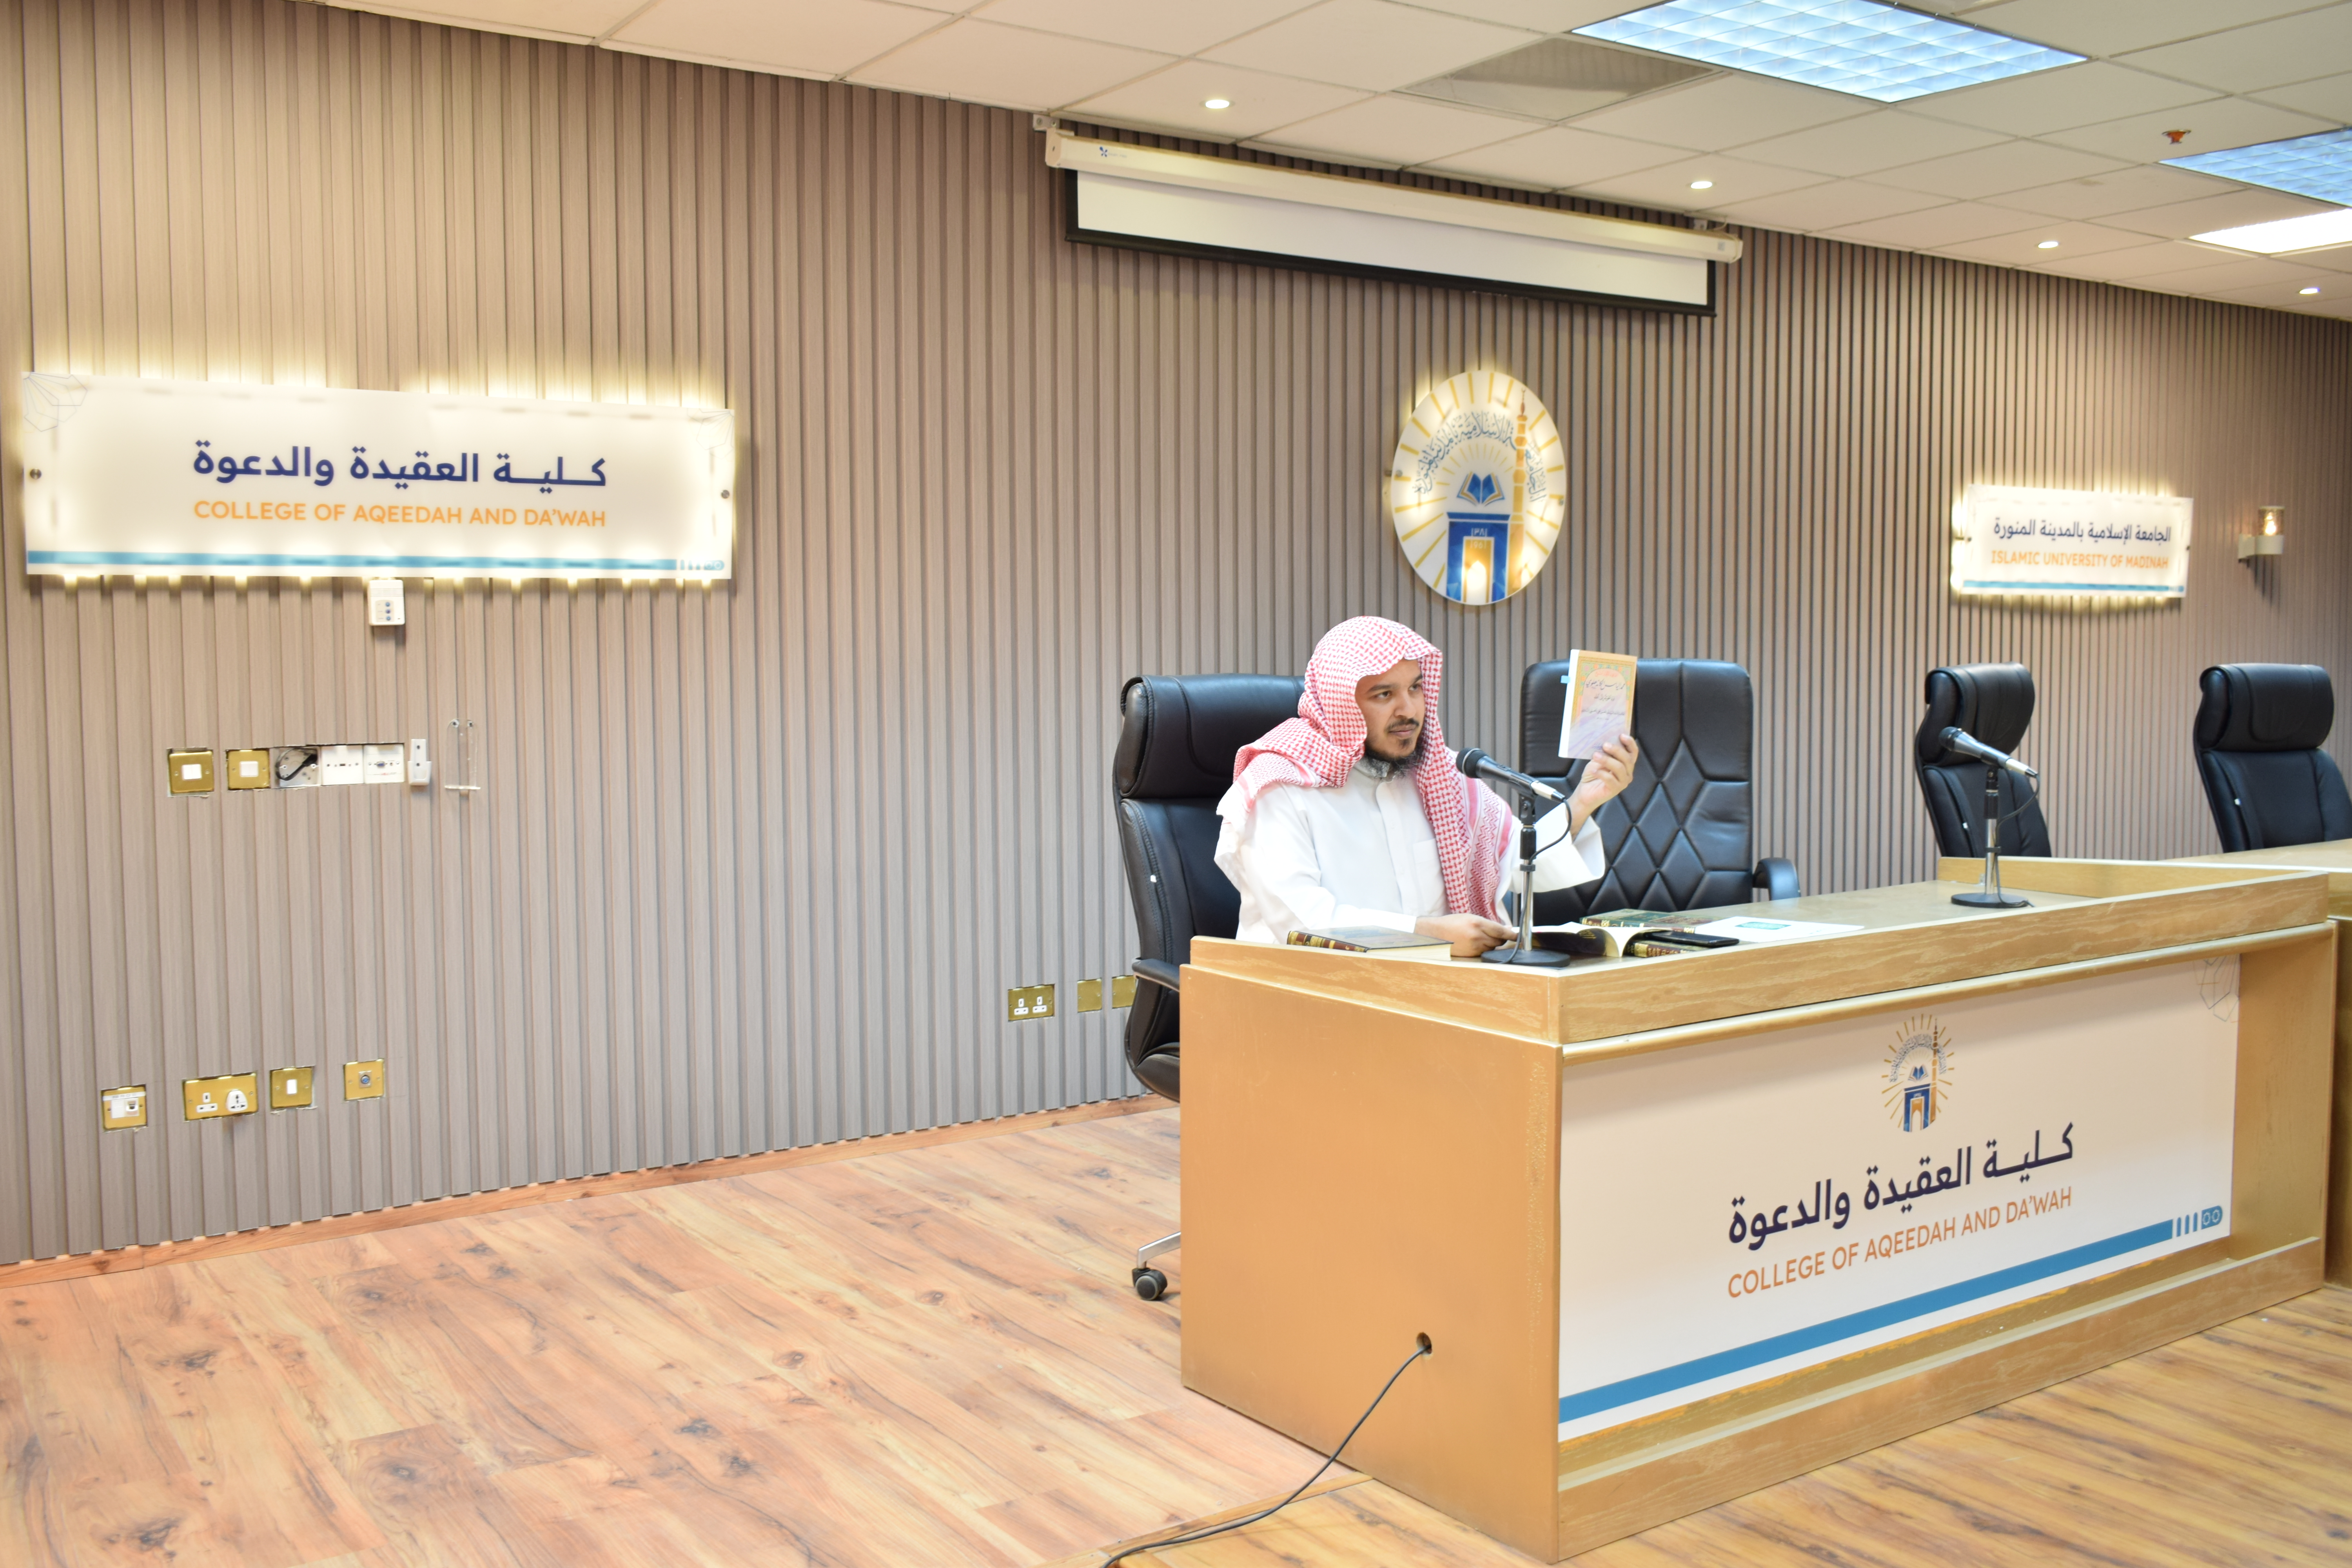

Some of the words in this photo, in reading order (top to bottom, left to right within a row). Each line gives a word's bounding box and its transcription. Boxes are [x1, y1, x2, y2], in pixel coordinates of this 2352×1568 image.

[193, 439, 335, 487] والدعوة
[349, 446, 479, 490] العقيدة
[493, 452, 607, 495] كلية
[193, 500, 307, 521] COLLEGE
[314, 503, 346, 522] OF
[353, 505, 462, 524] AQEEDAH
[469, 508, 517, 525] AND
[1994, 517, 2035, 539] المنورة
[2040, 519, 2083, 542] بالمدينة
[2088, 522, 2132, 544] الإسلامية
[2135, 525, 2171, 545] الجامعة
[1991, 550, 2040, 565] ISLAMIC
[2043, 552, 2108, 566] UNIVERSITY
[2111, 555, 2123, 568] OF
[2125, 555, 2170, 569] MADINAH
[1983, 1122, 2074, 1183] كلية
[1864, 1145, 1972, 1214] العقيدة
[1728, 1178, 1851, 1251] والدعوة
[1728, 1251, 1825, 1298] COLLEGE
[1832, 1242, 1859, 1270] OF
[1865, 1217, 1956, 1260] AQEEDAH
[1962, 1206, 2000, 1234] AND
